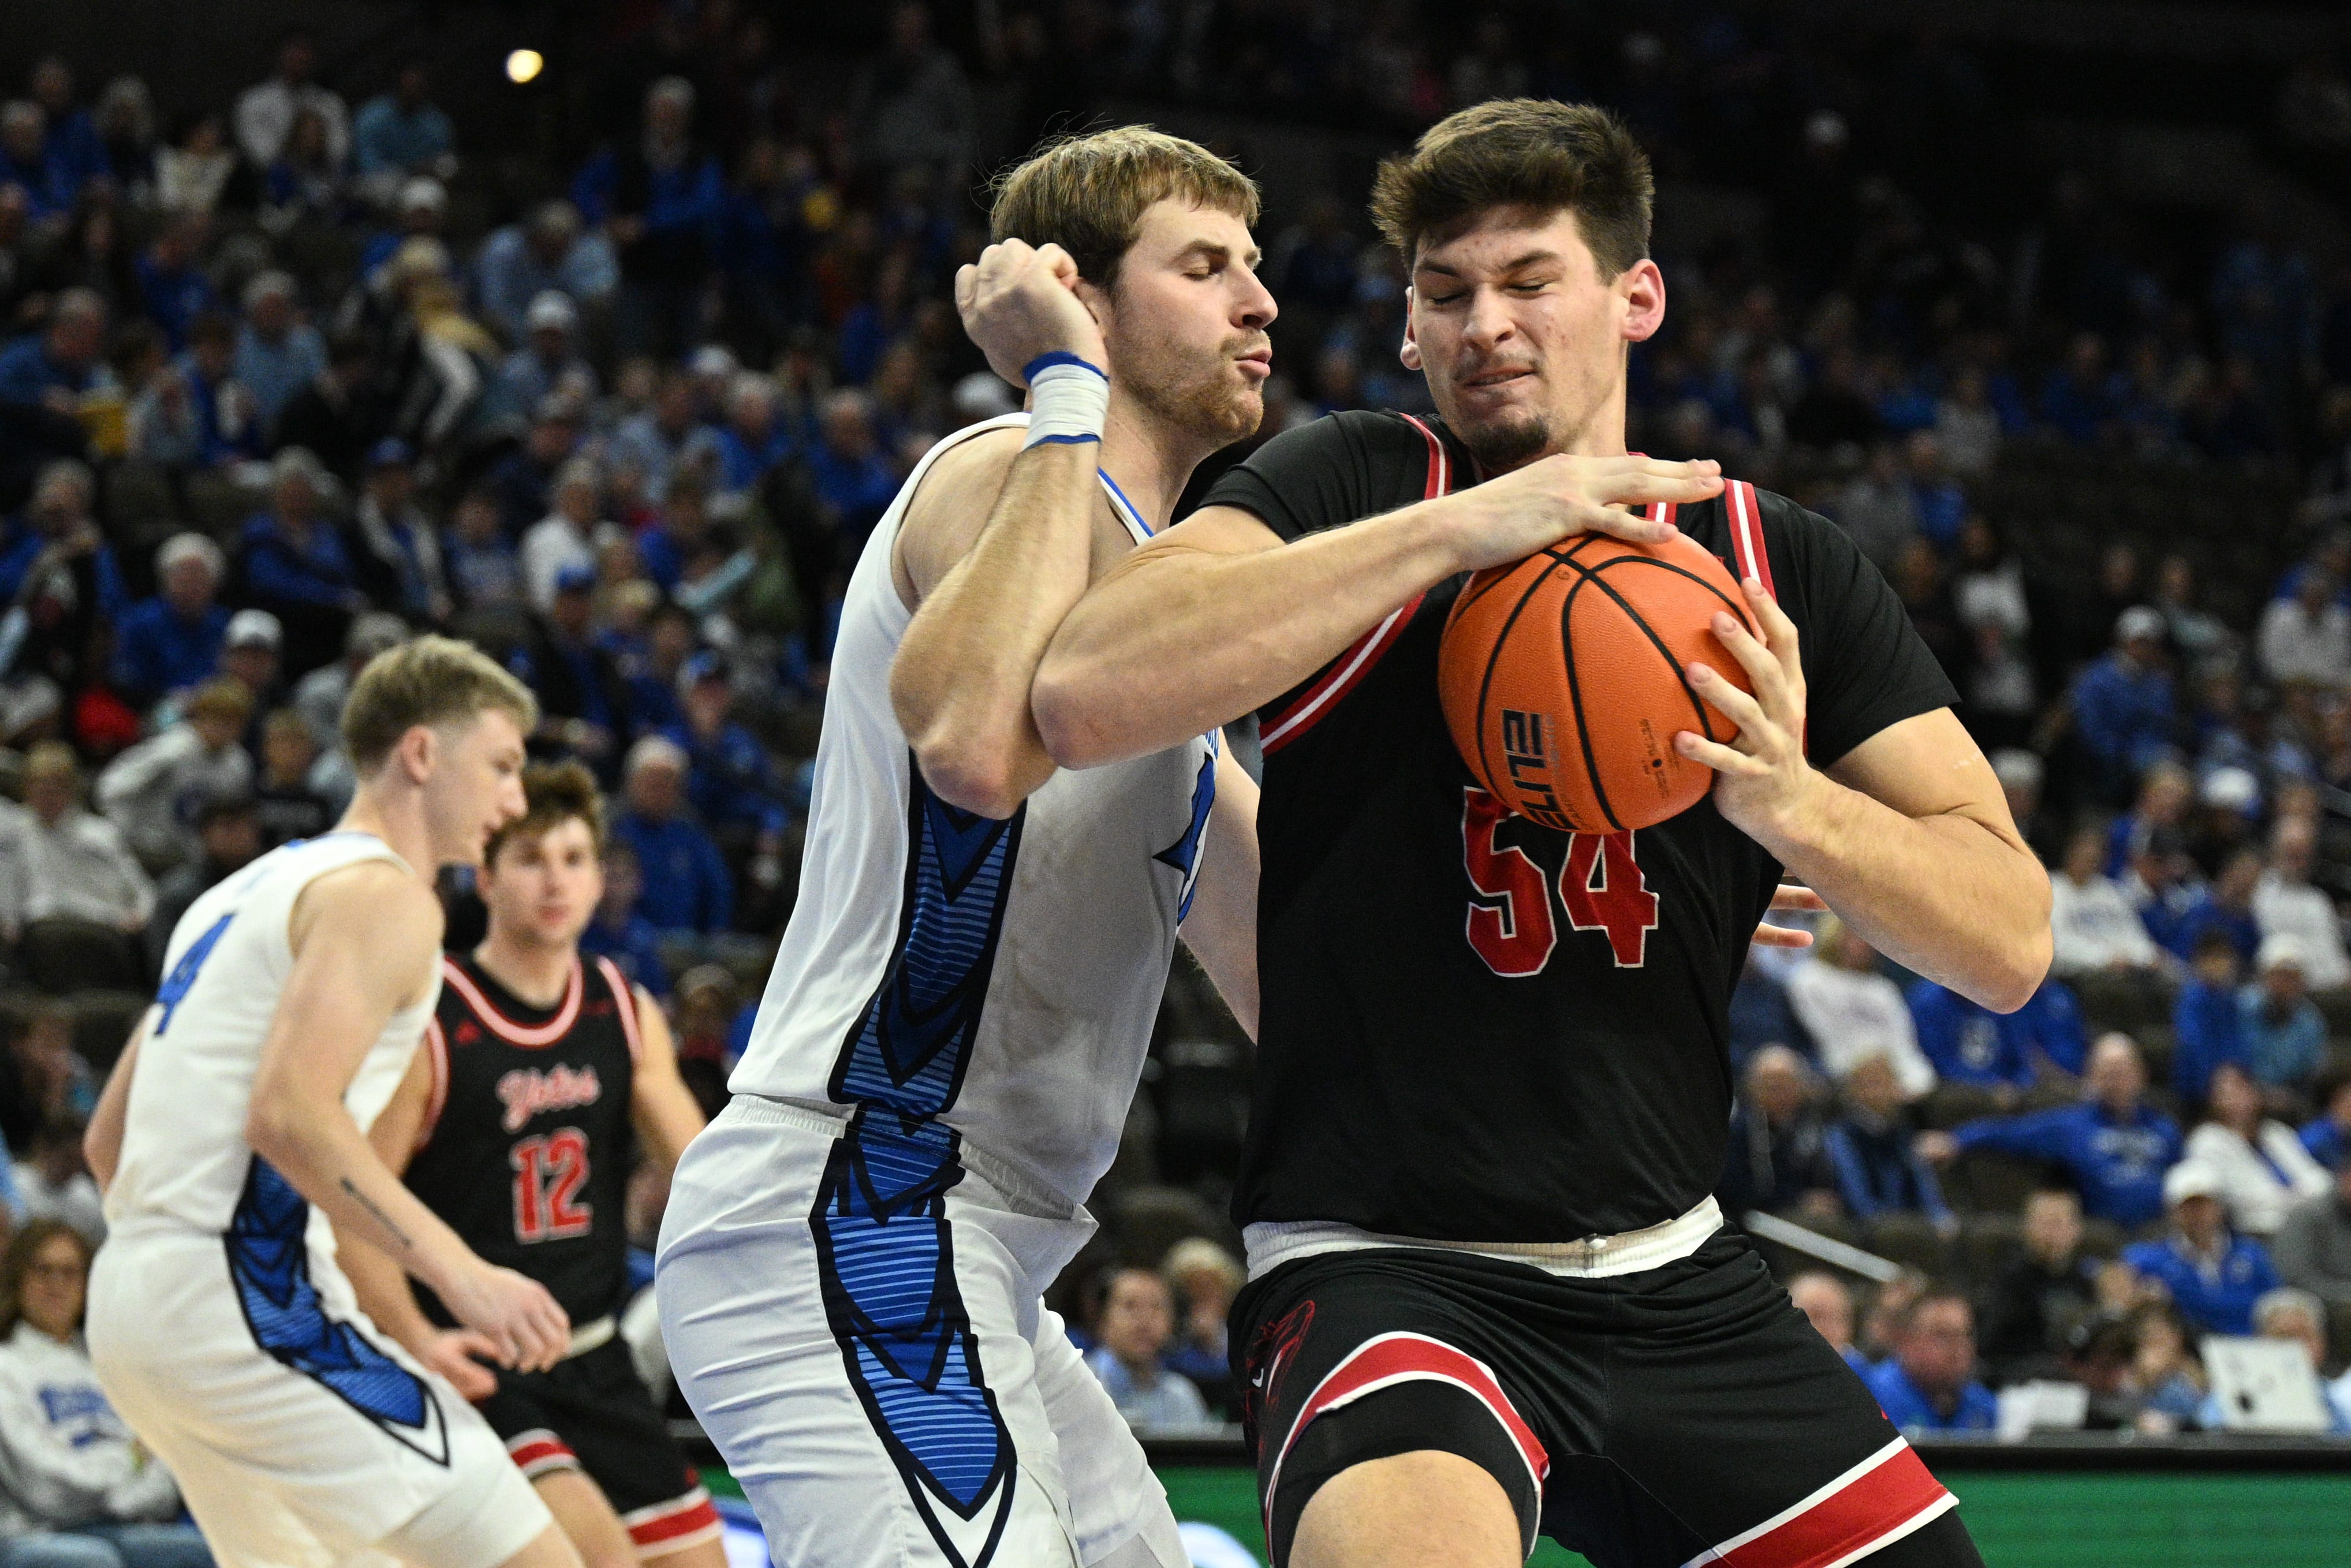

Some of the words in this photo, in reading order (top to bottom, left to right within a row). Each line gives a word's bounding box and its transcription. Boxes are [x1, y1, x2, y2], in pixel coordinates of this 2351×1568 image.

[1461, 785, 1659, 977] 54
[154, 910, 238, 1039] 4
[510, 1128, 593, 1244] 12
